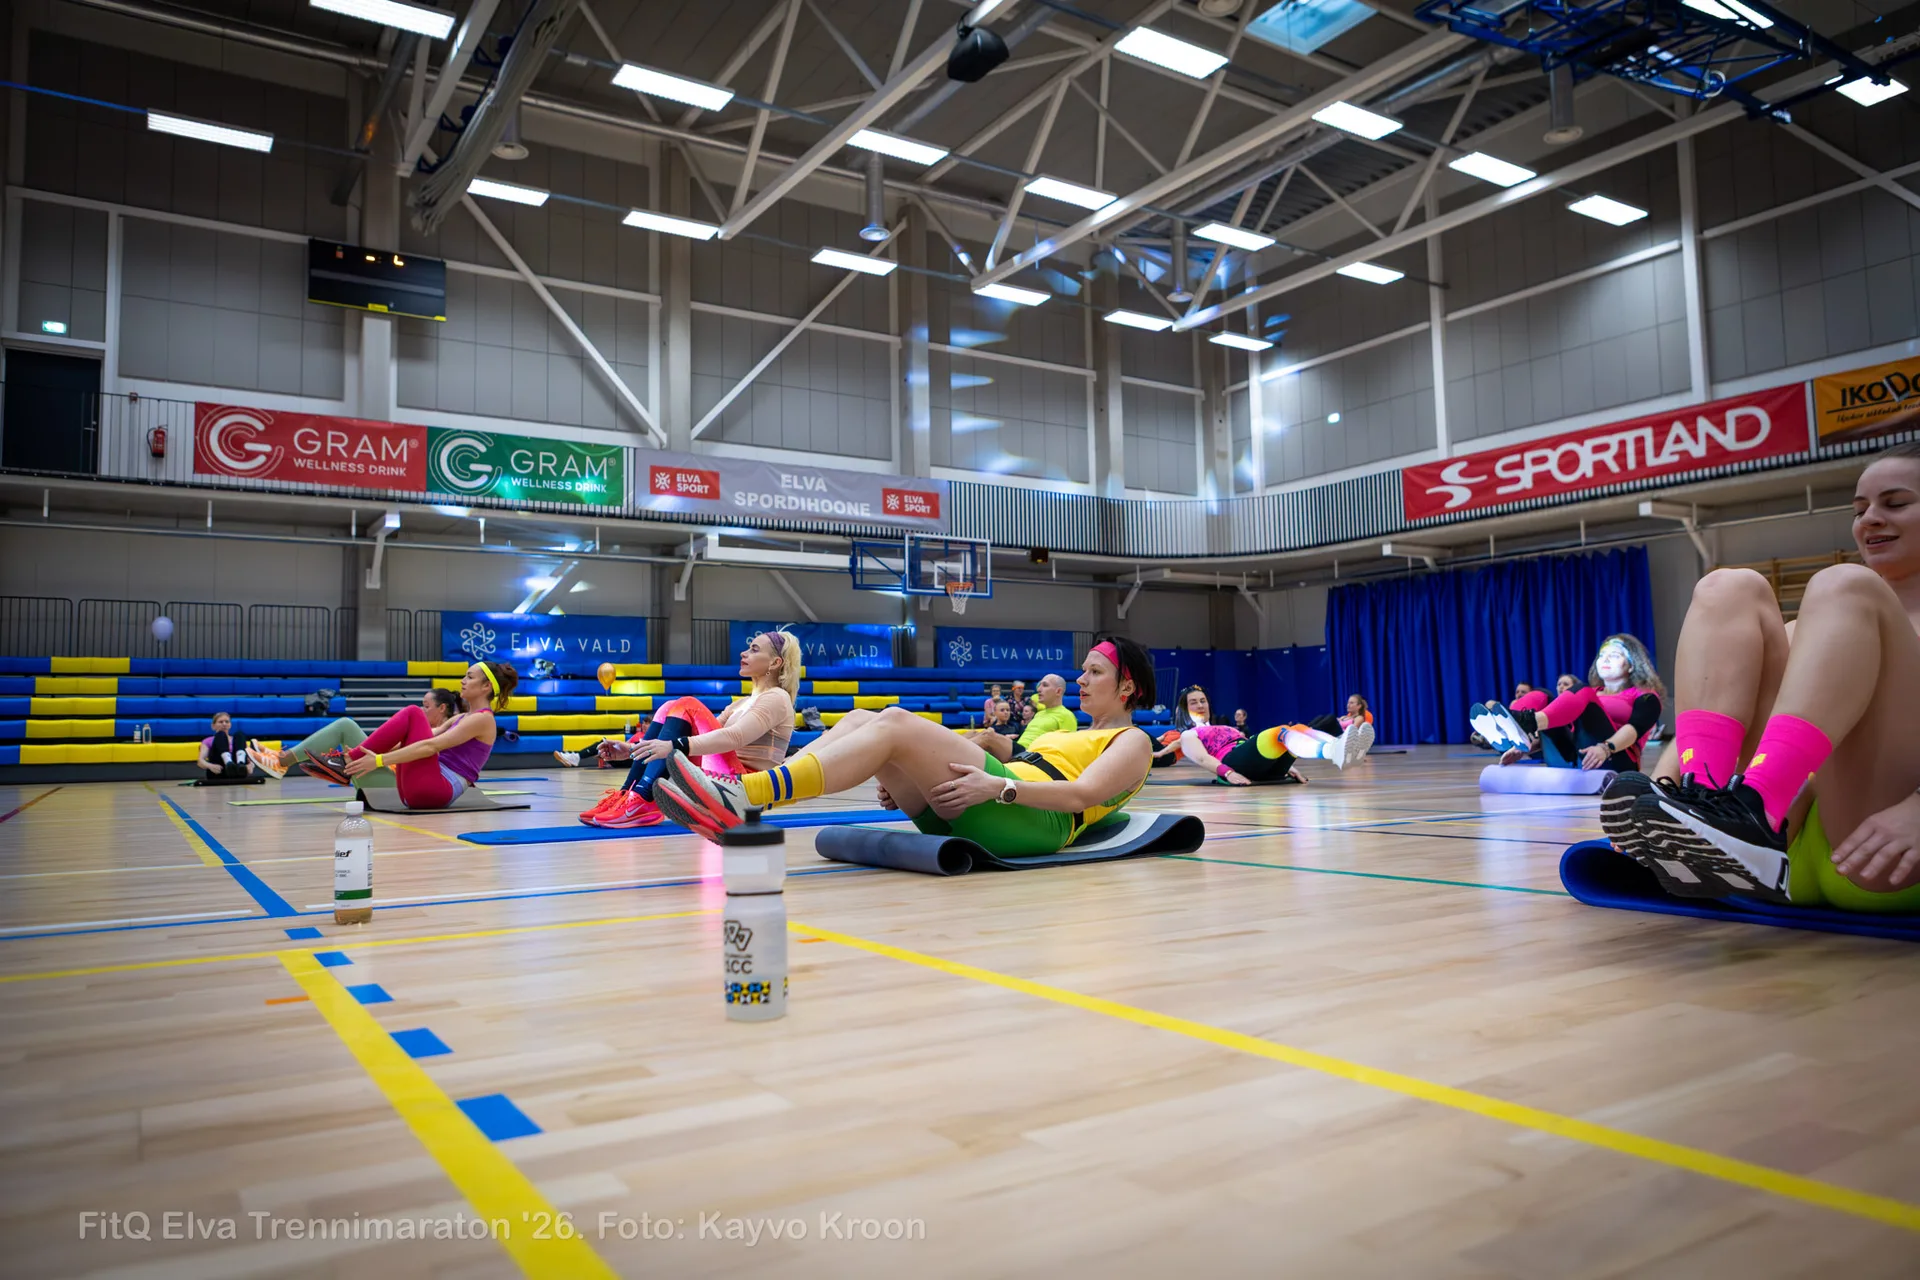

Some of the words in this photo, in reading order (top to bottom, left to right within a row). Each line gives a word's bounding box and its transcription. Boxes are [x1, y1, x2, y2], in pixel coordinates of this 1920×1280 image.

[1495, 406, 1771, 494] SPORTLAND
[293, 457, 365, 474] WELLNESS
[369, 465, 407, 477] DRINK
[510, 477, 572, 491] WELLNESS
[575, 482, 607, 493] DRINK
[676, 473, 701, 484] ELVA
[781, 474, 828, 492] ELVA
[676, 482, 710, 494] SPORT
[734, 491, 871, 517] SPORDIHOONE
[903, 495, 925, 505] ELVA
[903, 503, 931, 514] SPORT
[511, 633, 565, 652] ELVA
[578, 638, 631, 653] VALD
[836, 644, 879, 658] VALD
[981, 648, 1018, 660] ELVA
[1026, 649, 1064, 661] VALD
